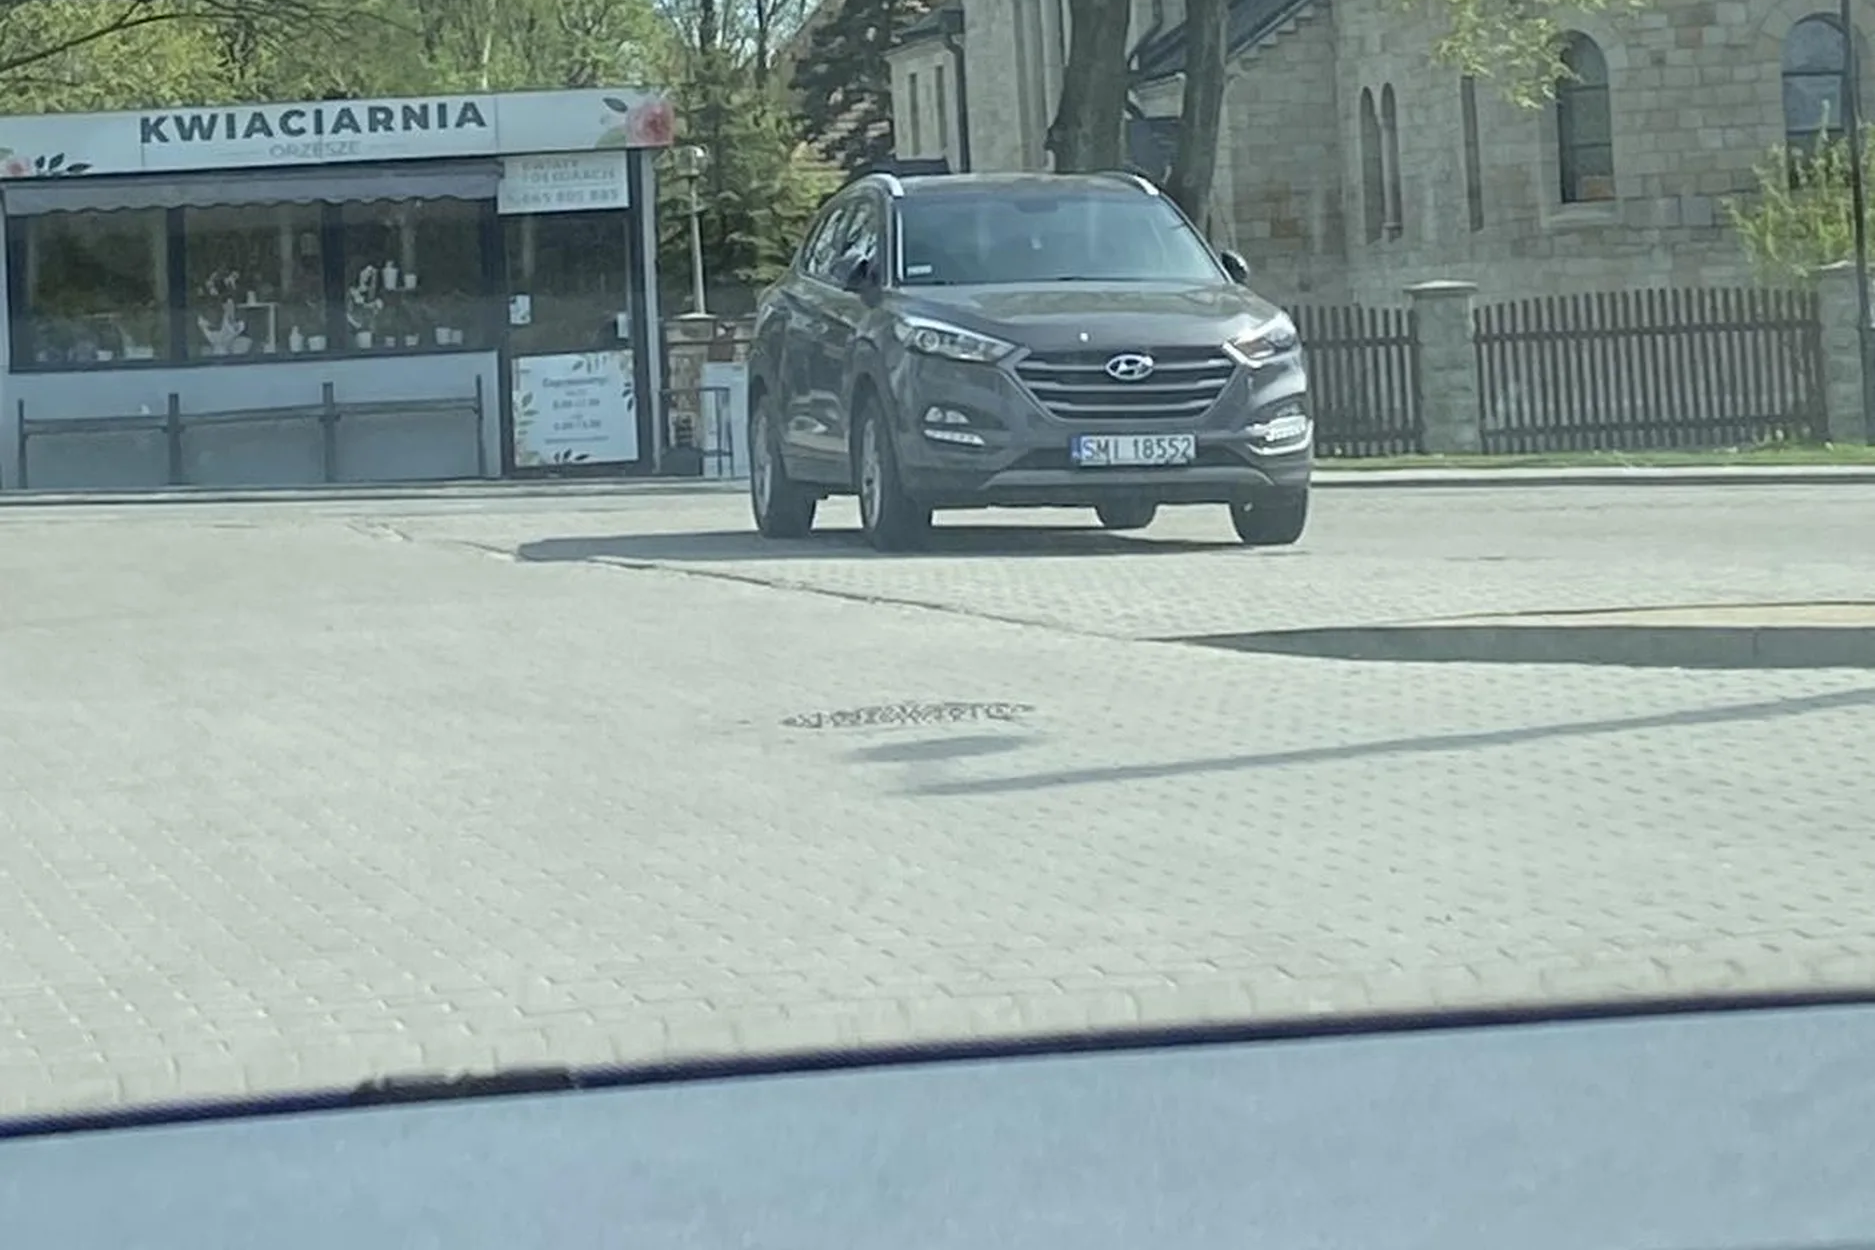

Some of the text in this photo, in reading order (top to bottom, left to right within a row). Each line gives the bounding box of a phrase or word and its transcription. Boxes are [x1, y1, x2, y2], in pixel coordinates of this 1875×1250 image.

[139, 101, 487, 144] KWIACIARNIA
[268, 140, 362, 158] ORZESZE
[1132, 436, 1192, 460] 18552
